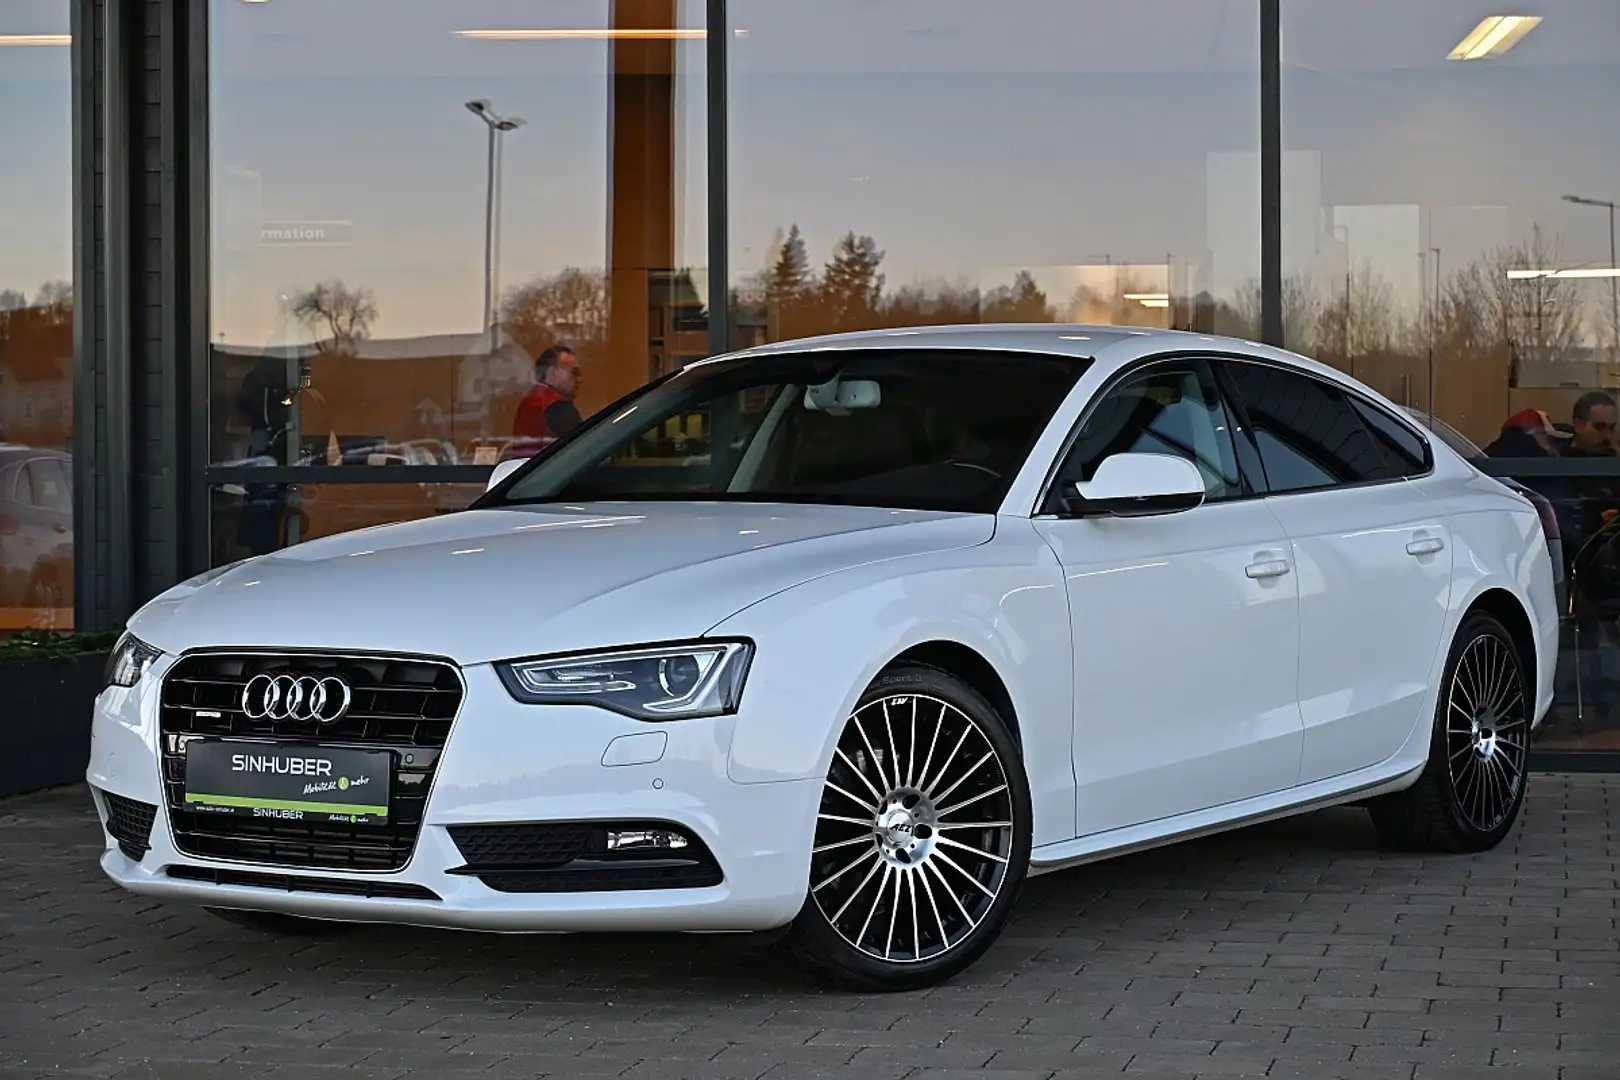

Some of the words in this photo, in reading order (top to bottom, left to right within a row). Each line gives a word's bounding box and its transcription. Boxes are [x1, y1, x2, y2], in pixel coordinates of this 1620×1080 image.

[232, 754, 332, 776] SINHUBER
[350, 775, 370, 787] mehr
[253, 807, 304, 820] SINHUBER
[890, 824, 910, 832] AEZ
